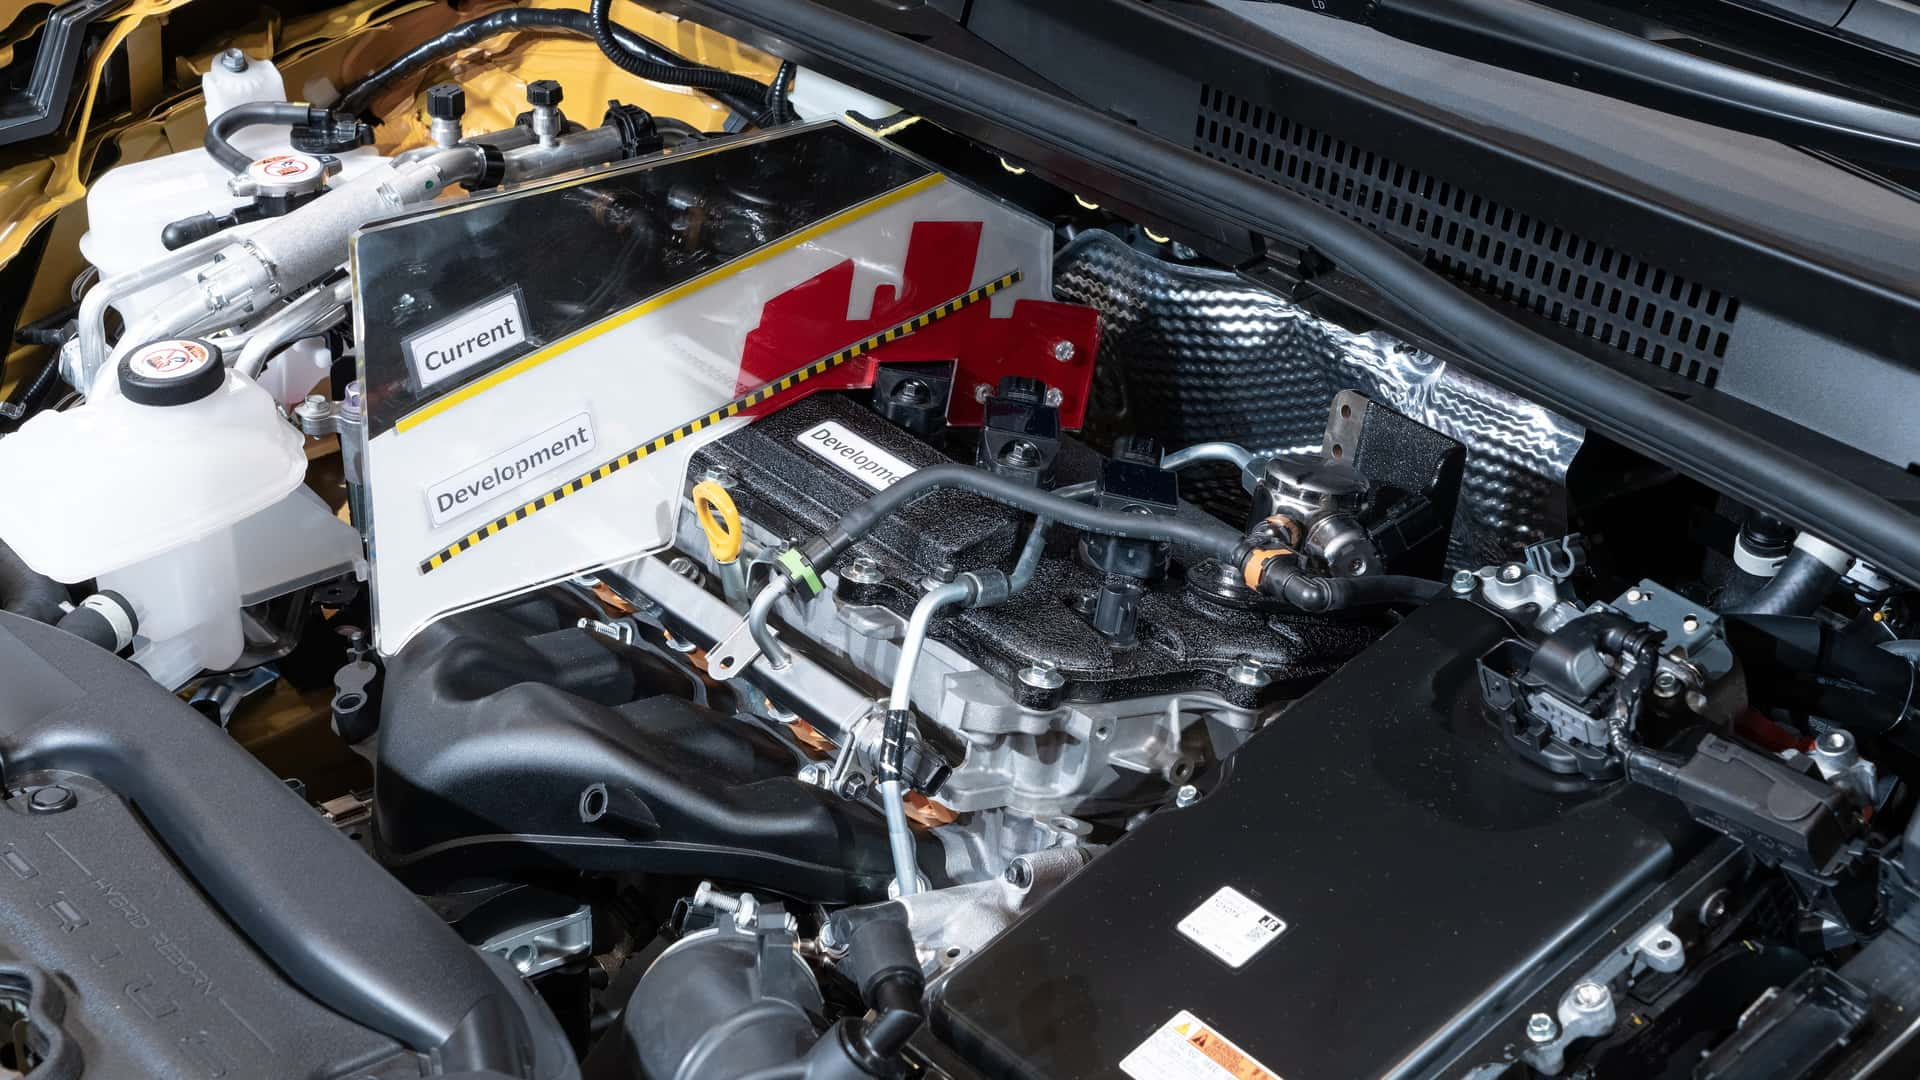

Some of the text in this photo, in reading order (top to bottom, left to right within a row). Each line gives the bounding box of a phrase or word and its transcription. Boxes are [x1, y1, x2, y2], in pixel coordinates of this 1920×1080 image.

[425, 317, 516, 371] Current
[437, 427, 589, 513] Development
[811, 428, 900, 485] Developme
